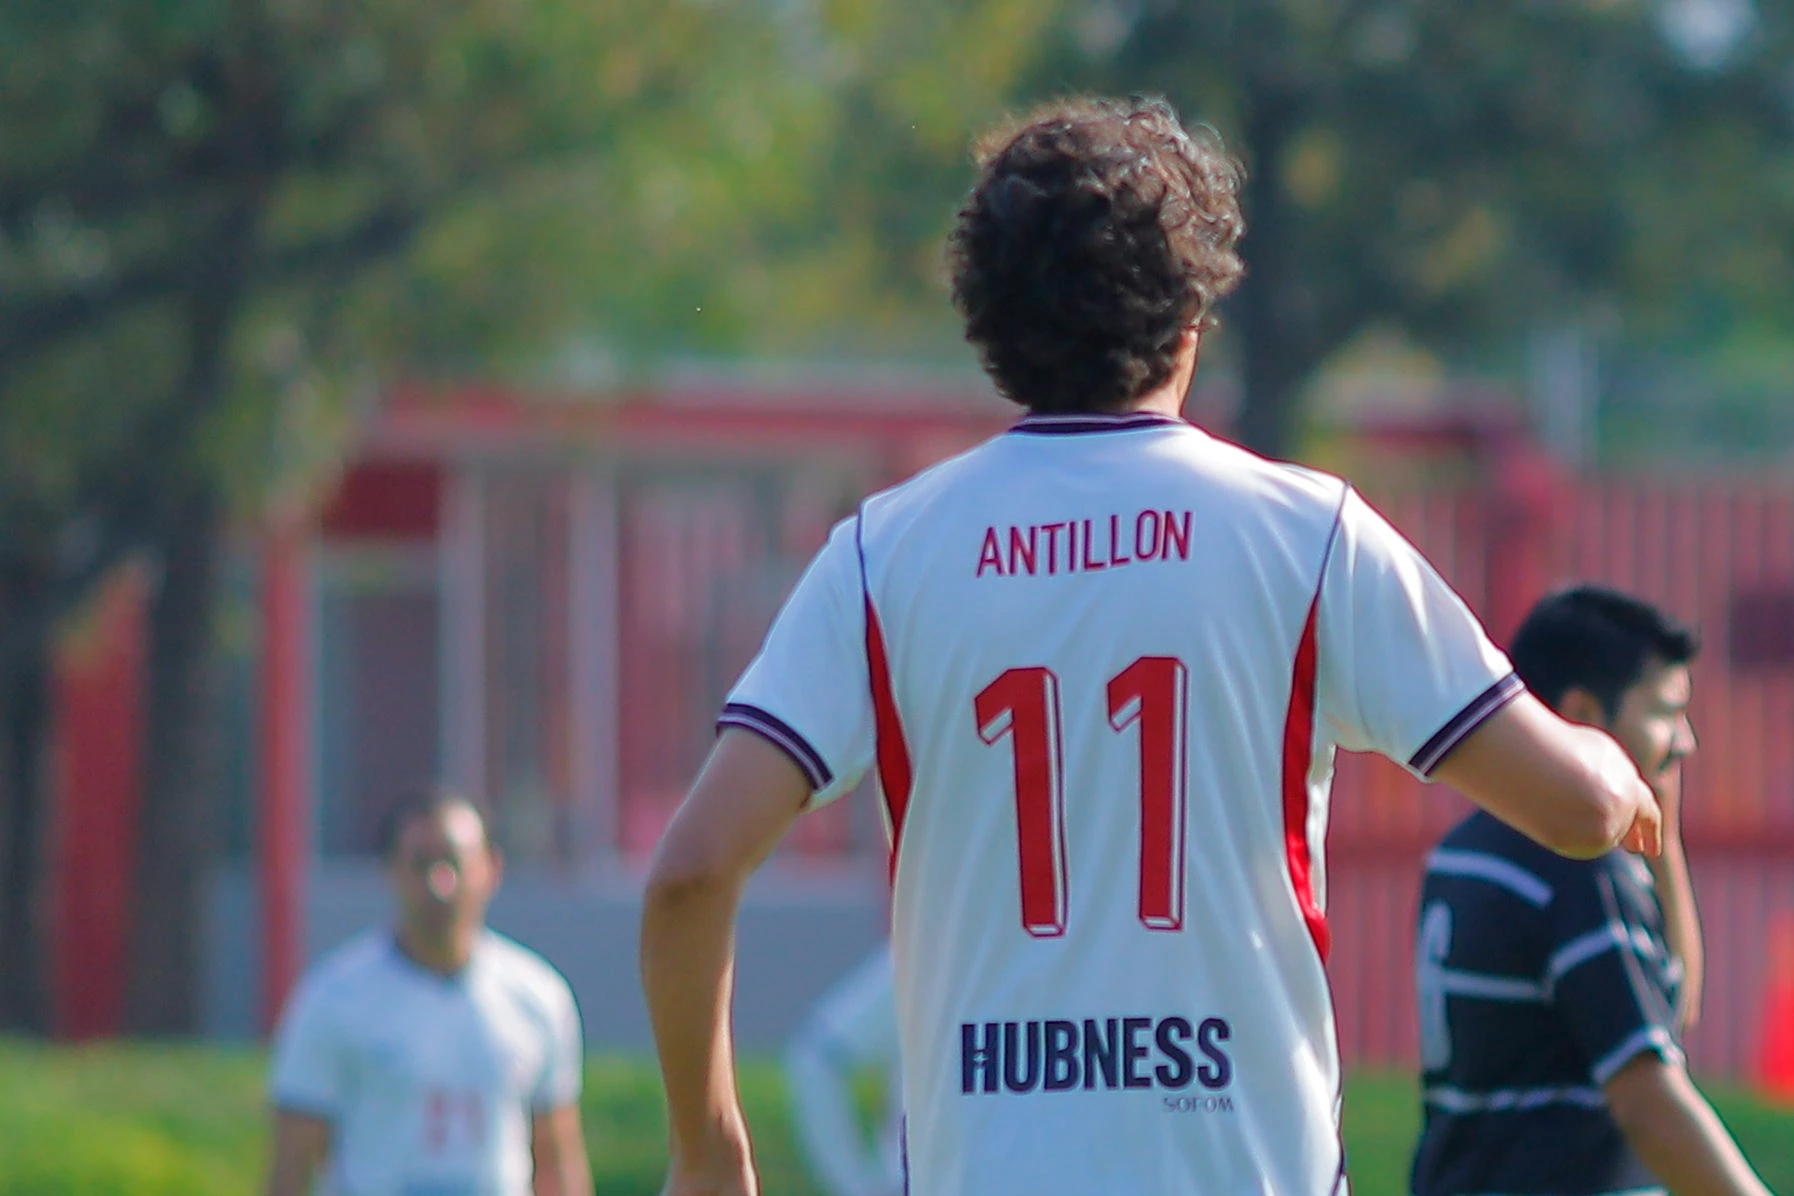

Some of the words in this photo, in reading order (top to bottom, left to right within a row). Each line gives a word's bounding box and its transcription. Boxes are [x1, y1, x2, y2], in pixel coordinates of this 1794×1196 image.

[976, 509, 1192, 578] ANTILLON
[973, 656, 1189, 939] 11
[961, 1016, 1231, 1094] HUBNESS
